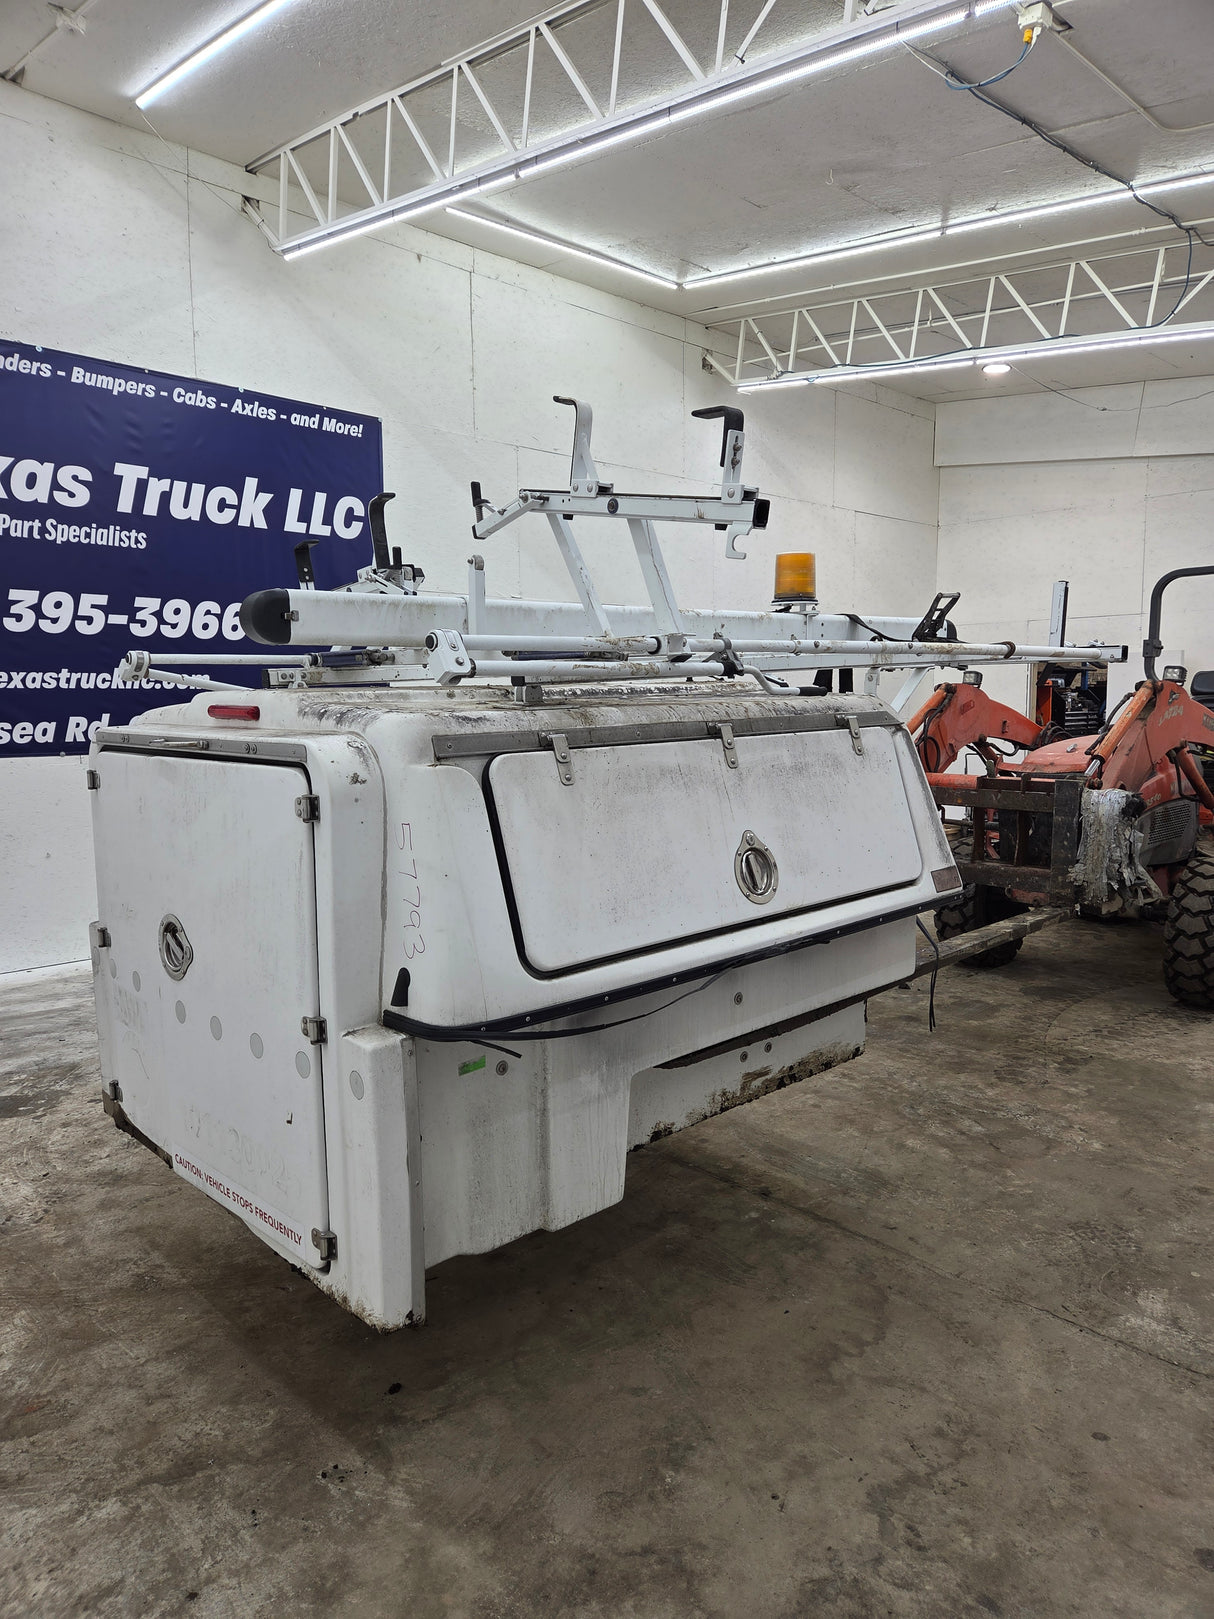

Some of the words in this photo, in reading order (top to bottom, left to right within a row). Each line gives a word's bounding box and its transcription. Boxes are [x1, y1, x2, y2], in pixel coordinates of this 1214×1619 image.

[71, 366, 157, 398] Bumpers
[172, 387, 217, 409] Cabs
[231, 399, 277, 421] Axles
[290, 412, 320, 429] and
[322, 417, 363, 438] More!
[0, 513, 41, 539] Part
[44, 518, 147, 549] Specialists
[113, 462, 274, 530] Truck
[284, 487, 365, 540] LLC
[2, 588, 246, 641] 395-3966
[0, 721, 57, 745] sea
[394, 822, 426, 960] 57793
[174, 1153, 204, 1180] CAUTION:
[204, 1172, 231, 1199] VEHICLE
[232, 1191, 254, 1214] STOPS
[254, 1205, 302, 1246] FREQUENTLY
